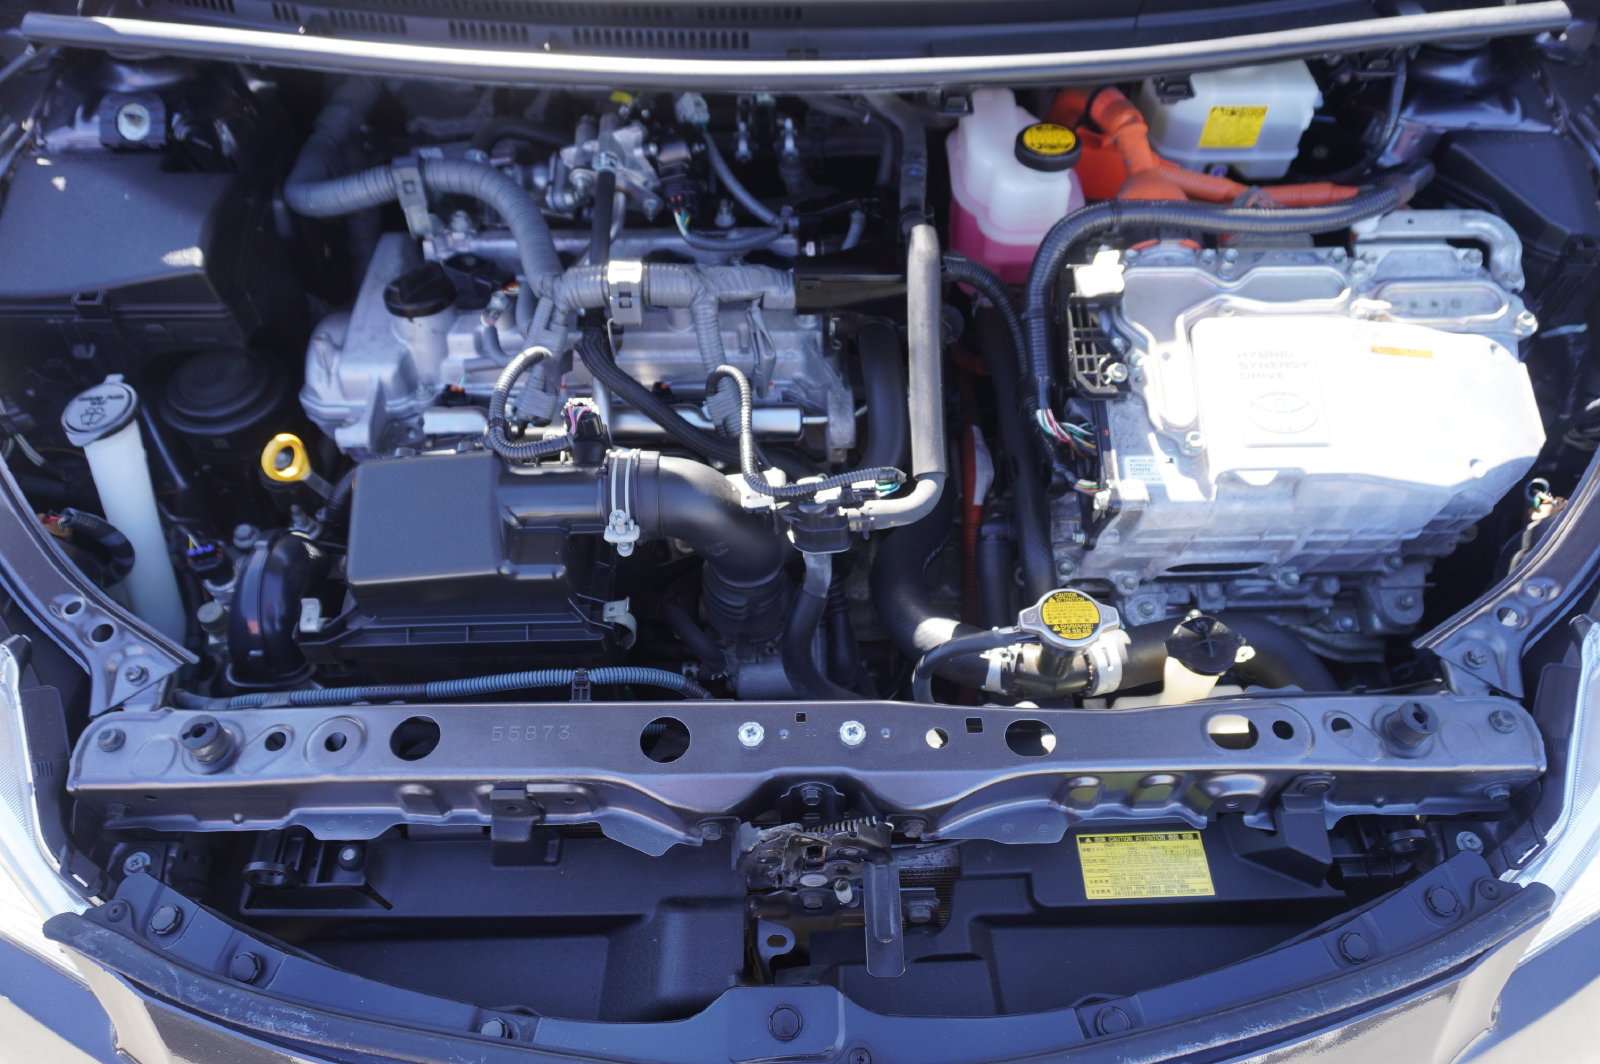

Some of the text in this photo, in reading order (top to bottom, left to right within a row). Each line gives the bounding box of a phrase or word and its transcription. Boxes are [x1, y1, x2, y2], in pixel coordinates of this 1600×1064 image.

[1236, 350, 1294, 359] HYBRID
[1238, 360, 1309, 369] SYNERGY
[1240, 371, 1284, 380] DRIVE
[490, 725, 570, 741] 55873
[1135, 834, 1166, 842] ATTENTION
